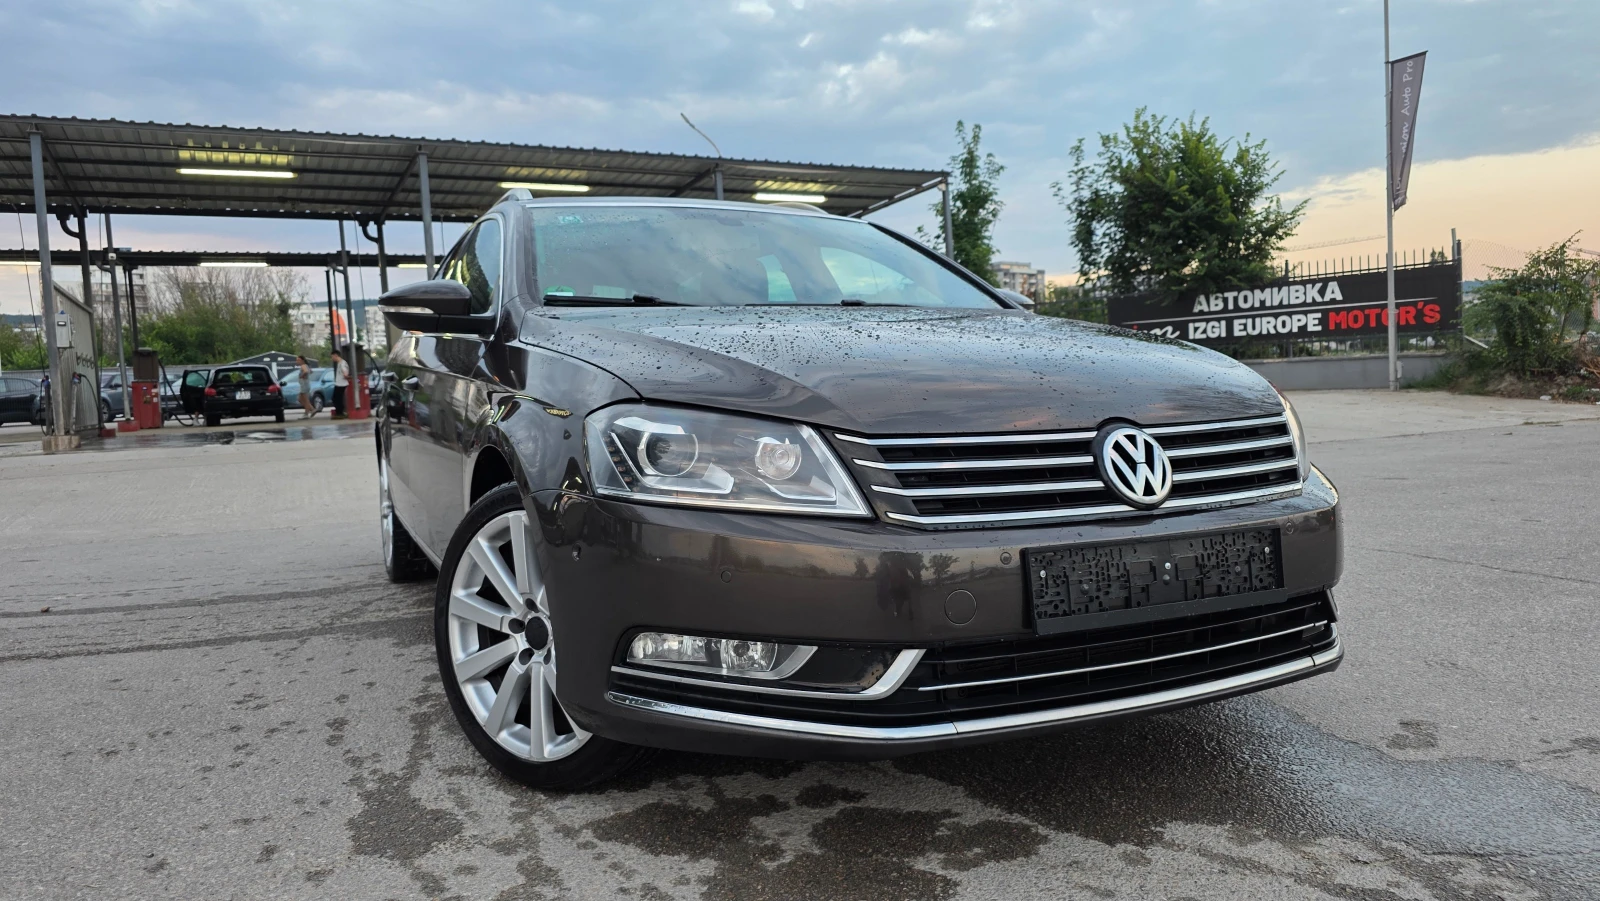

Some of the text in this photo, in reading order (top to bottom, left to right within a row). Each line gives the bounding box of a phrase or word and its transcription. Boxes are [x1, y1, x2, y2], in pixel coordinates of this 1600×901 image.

[1403, 60, 1414, 82] Pro
[1401, 87, 1411, 116] Auto
[1192, 281, 1343, 313] АВТОМИВКА
[1188, 320, 1226, 340] IZGI
[1233, 312, 1322, 337] EUROPE
[1106, 429, 1169, 501] VW
